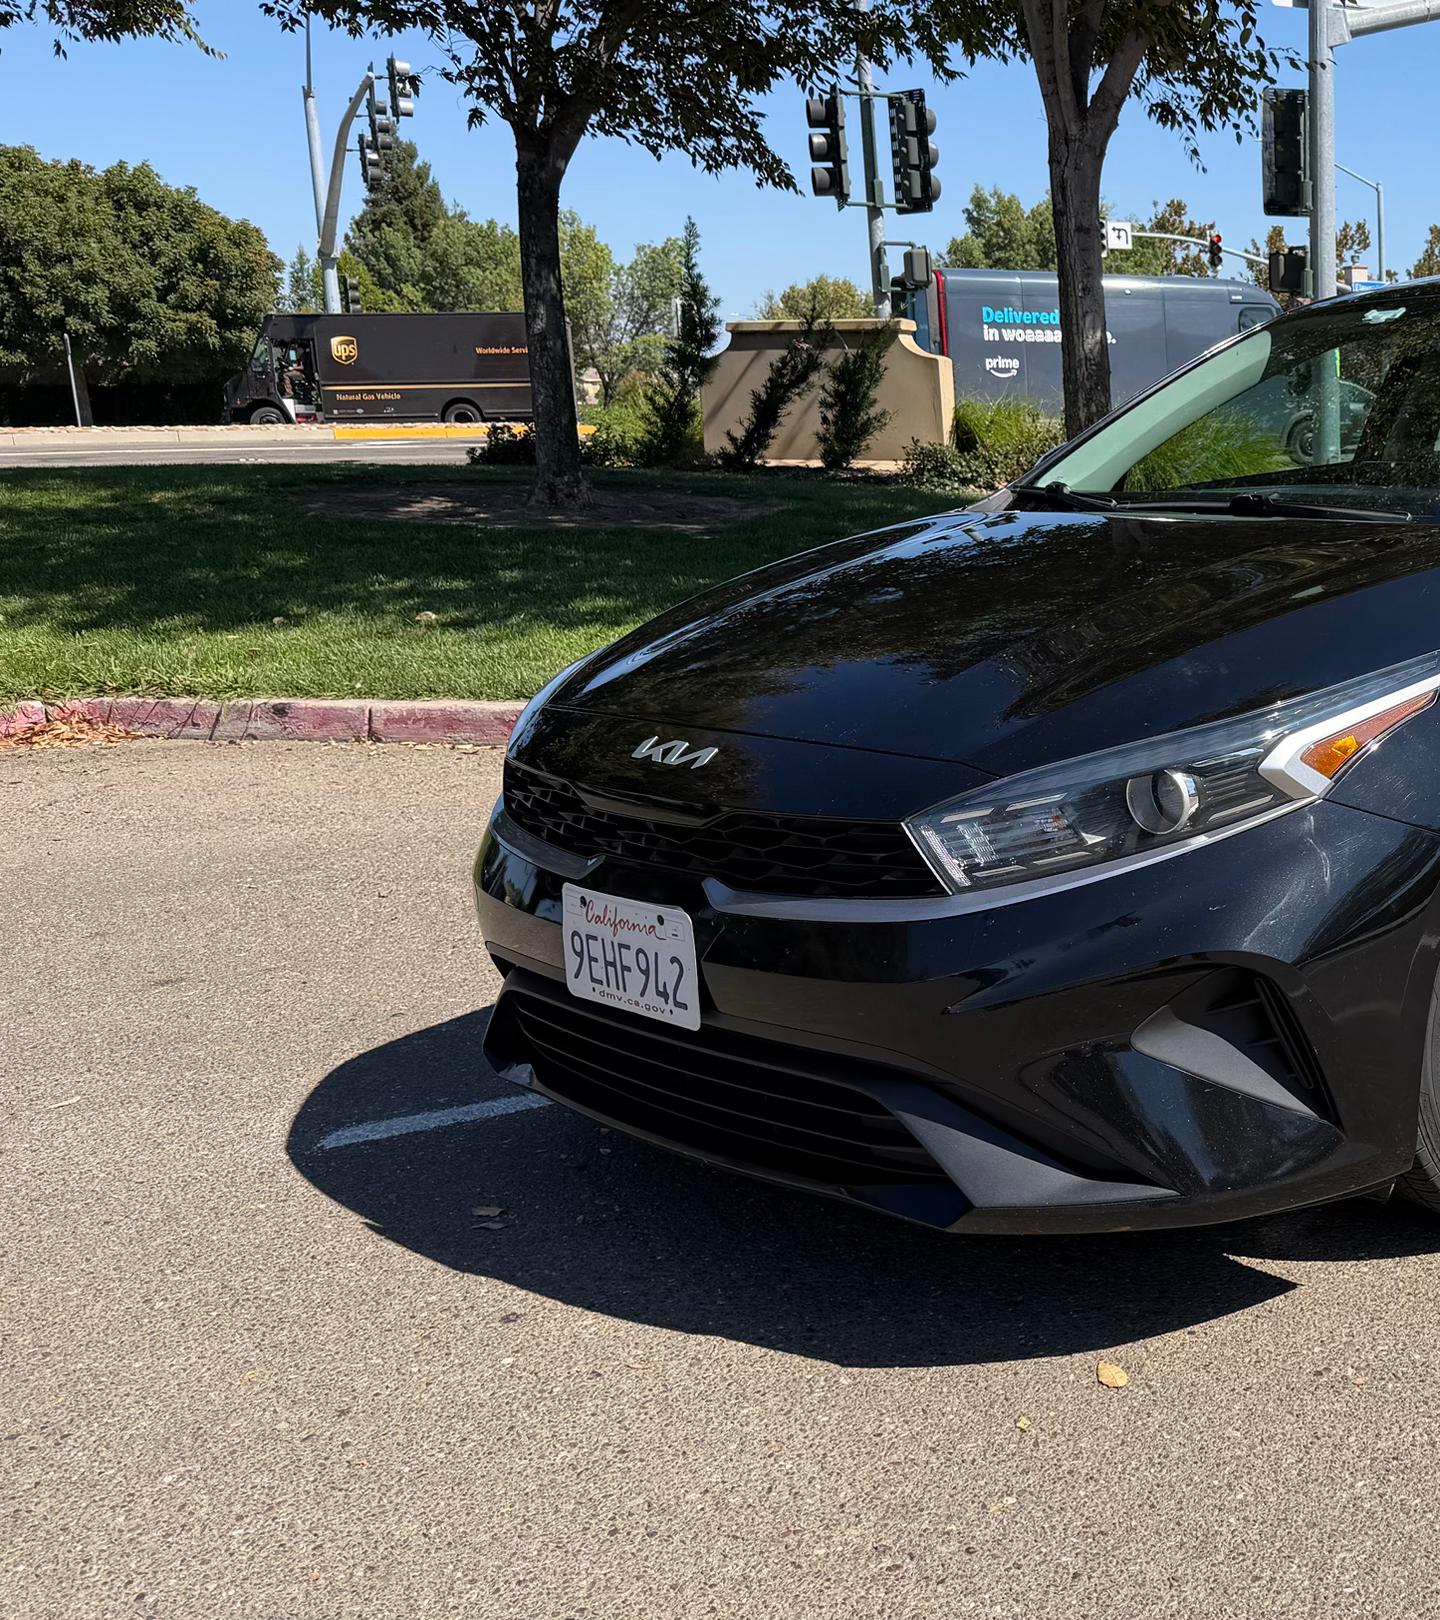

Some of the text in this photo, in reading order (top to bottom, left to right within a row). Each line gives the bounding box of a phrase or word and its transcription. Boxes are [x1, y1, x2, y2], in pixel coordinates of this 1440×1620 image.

[982, 306, 1060, 325] Delivered
[983, 324, 1063, 343] in woaaaa
[334, 344, 356, 360] ups
[475, 346, 529, 354] Worldwide Servi
[985, 355, 1020, 370] prime
[375, 392, 401, 400] Vehicle
[585, 899, 667, 941] California
[571, 930, 688, 1011] 9EHF942
[599, 989, 666, 1015] dmv.ca.gov
